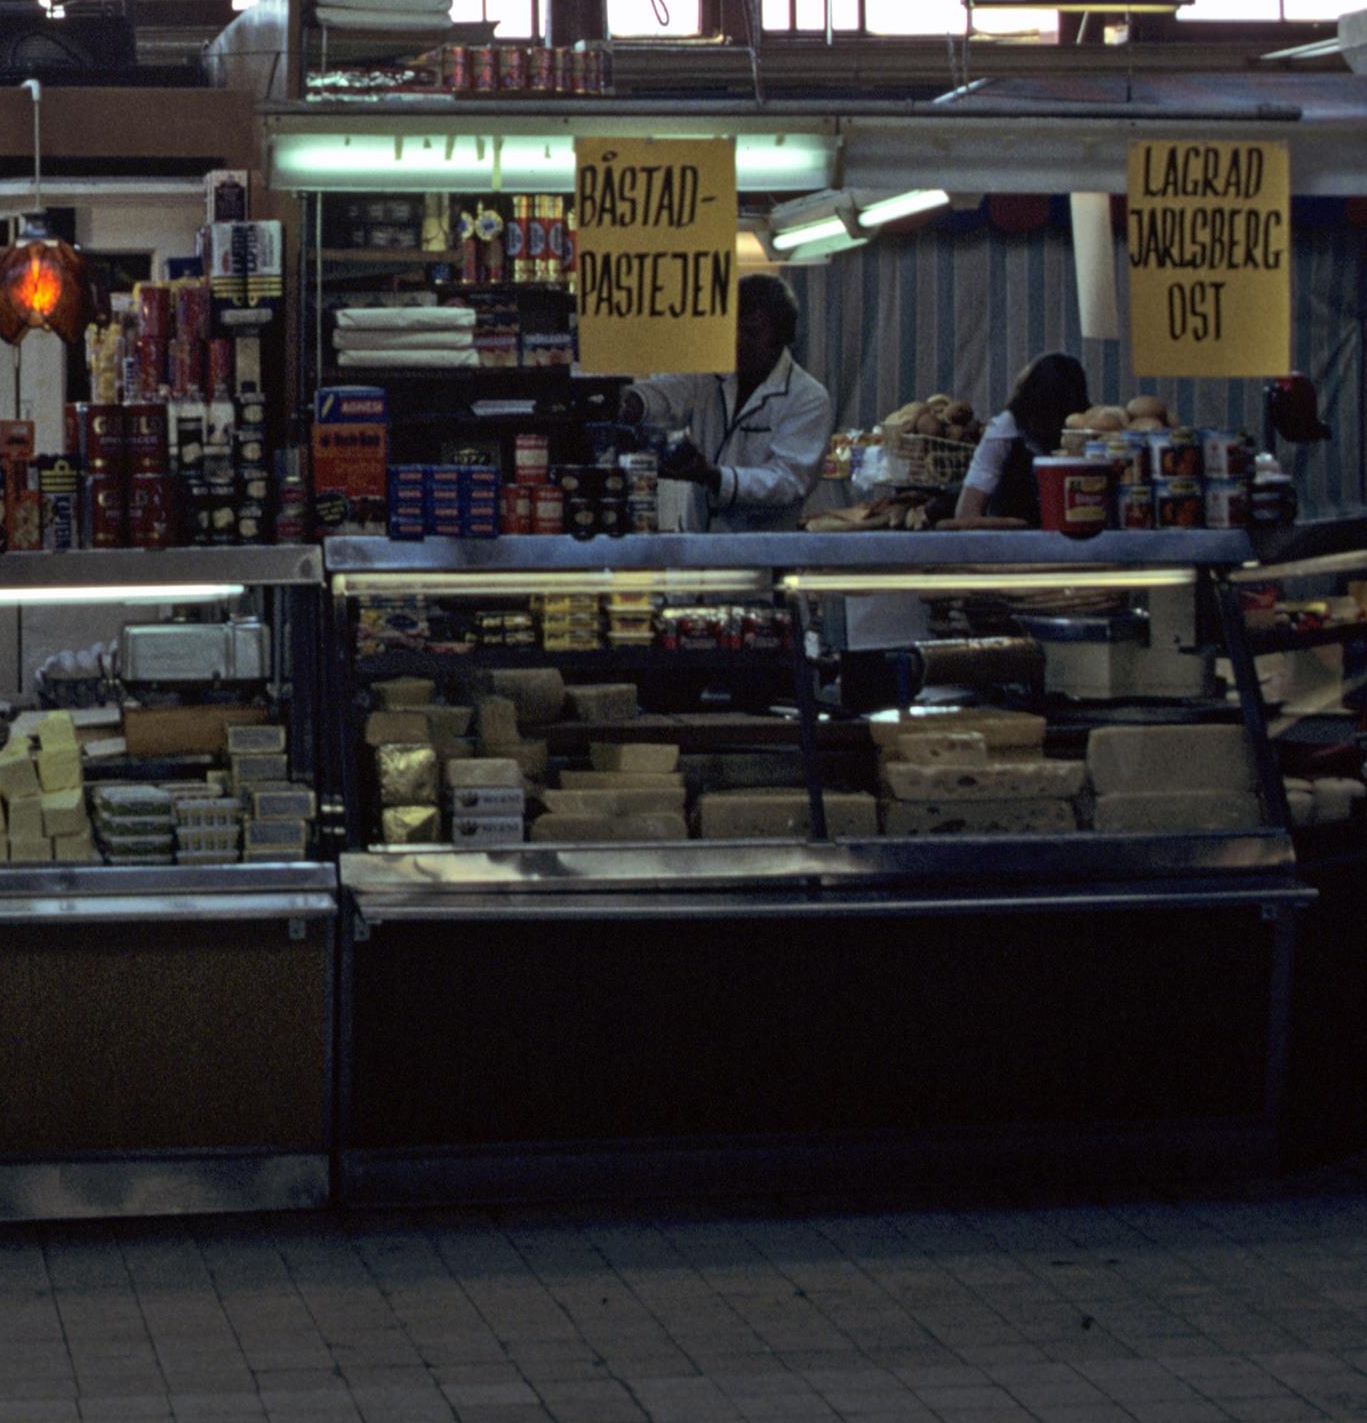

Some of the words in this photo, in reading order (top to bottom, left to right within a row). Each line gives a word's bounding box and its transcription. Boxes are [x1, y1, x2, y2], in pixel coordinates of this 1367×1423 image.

[579, 150, 717, 229] BÅSTAD-
[1143, 145, 1264, 198] LAGRAD
[1130, 207, 1284, 270] JARLSBERG
[579, 250, 731, 319] PASTEJEN
[1167, 281, 1226, 341] OST
